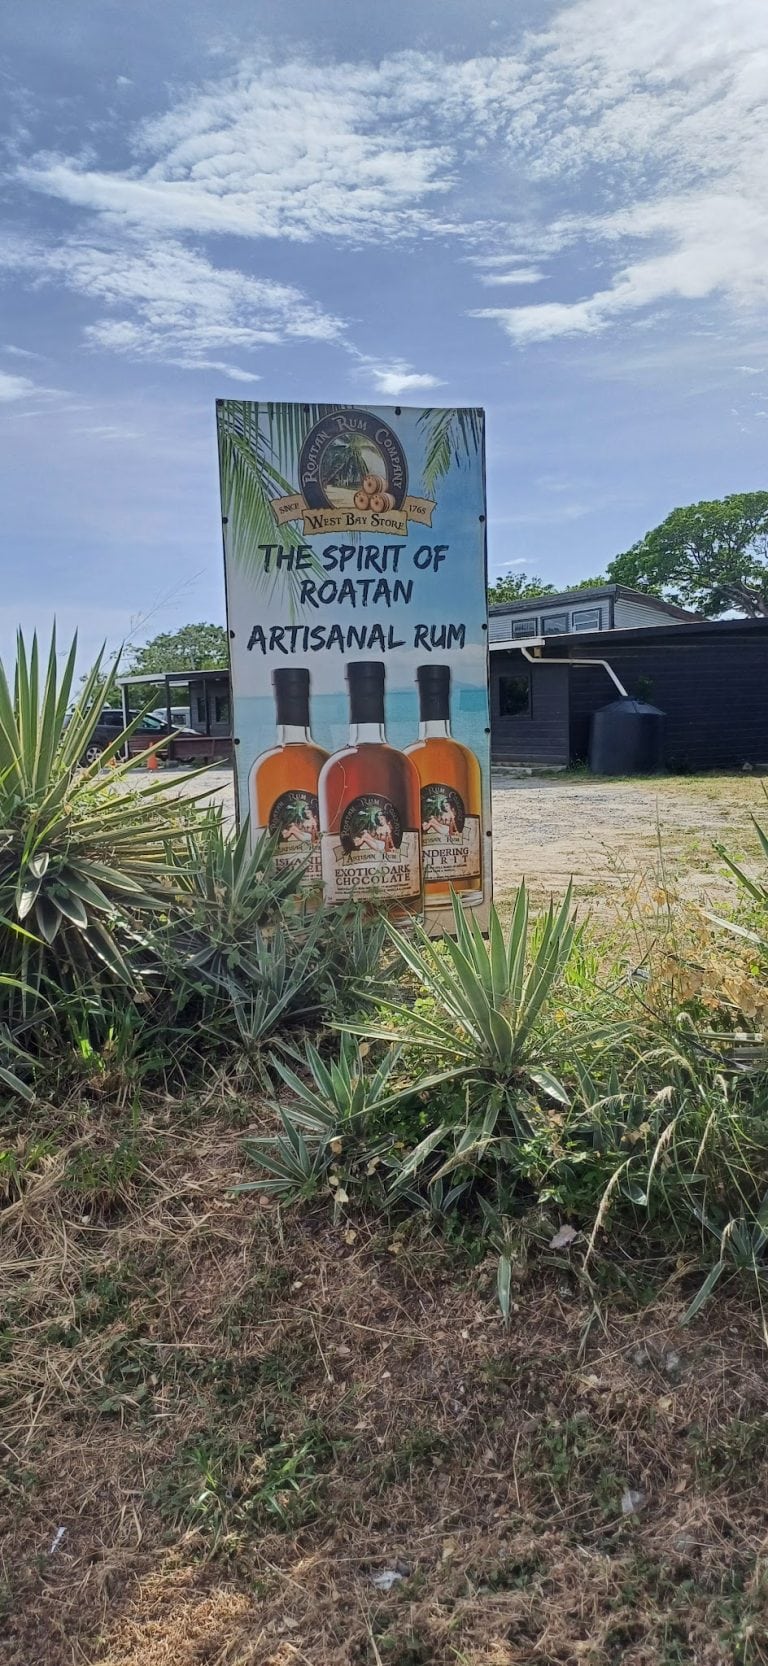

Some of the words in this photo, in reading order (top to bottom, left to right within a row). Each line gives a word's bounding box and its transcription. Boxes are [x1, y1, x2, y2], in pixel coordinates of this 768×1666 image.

[302, 430, 331, 487] ROATAN
[332, 415, 367, 431] RUM
[375, 428, 405, 489] COMPANY
[305, 514, 342, 529] WEST
[342, 512, 367, 526] BAY
[370, 513, 405, 530] STORE
[257, 544, 312, 573] THE
[322, 544, 407, 573] SPIRIT
[413, 544, 449, 572] OF
[299, 578, 414, 608] ROATAN
[246, 624, 406, 654] ARTISANAL
[414, 624, 466, 652] RUM
[335, 867, 376, 877] EXOTIC
[381, 864, 411, 875] DARK
[421, 855, 468, 866] IRIT
[335, 873, 411, 886] CHOCOLATE
